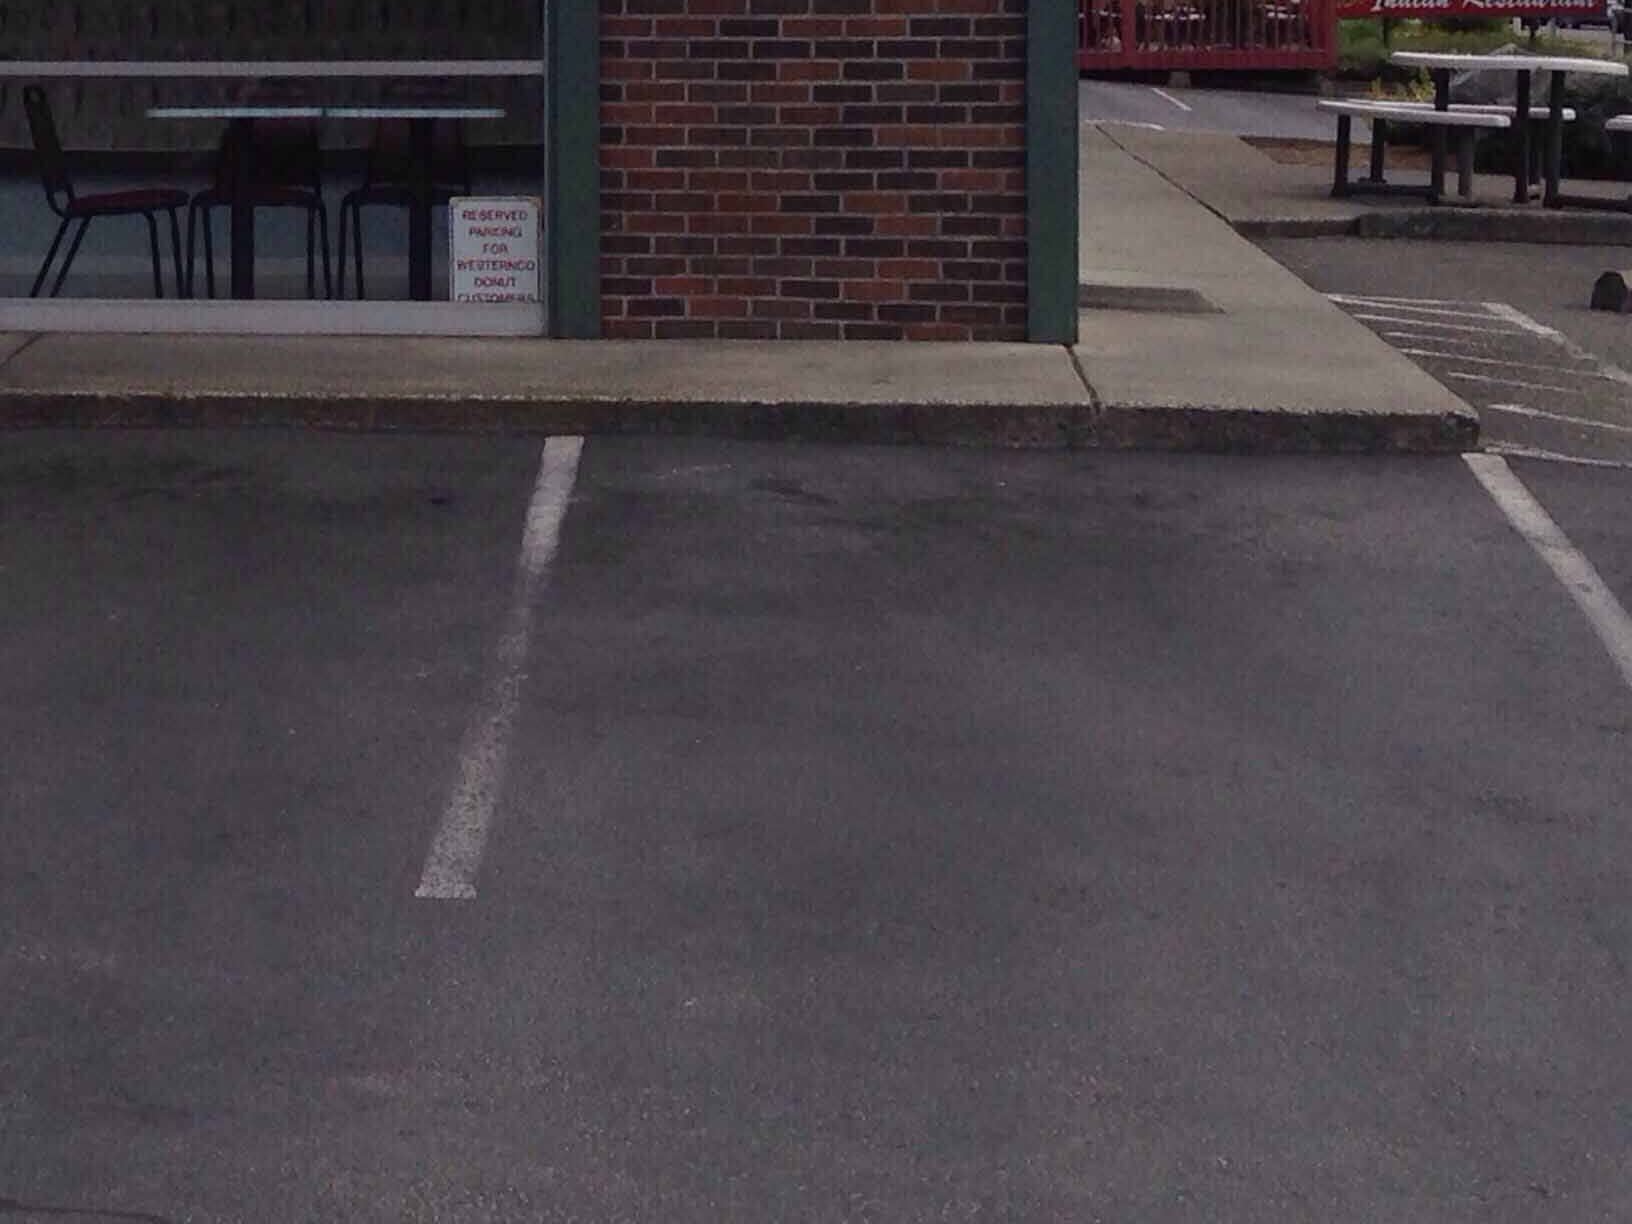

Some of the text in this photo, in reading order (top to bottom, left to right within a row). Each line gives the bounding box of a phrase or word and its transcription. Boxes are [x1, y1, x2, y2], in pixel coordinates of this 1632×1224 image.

[462, 209, 529, 222] RESERVED
[469, 226, 523, 238] PARKING
[482, 242, 509, 255] FOR
[457, 259, 536, 271] WESTERNCO
[474, 276, 516, 288] DONUT
